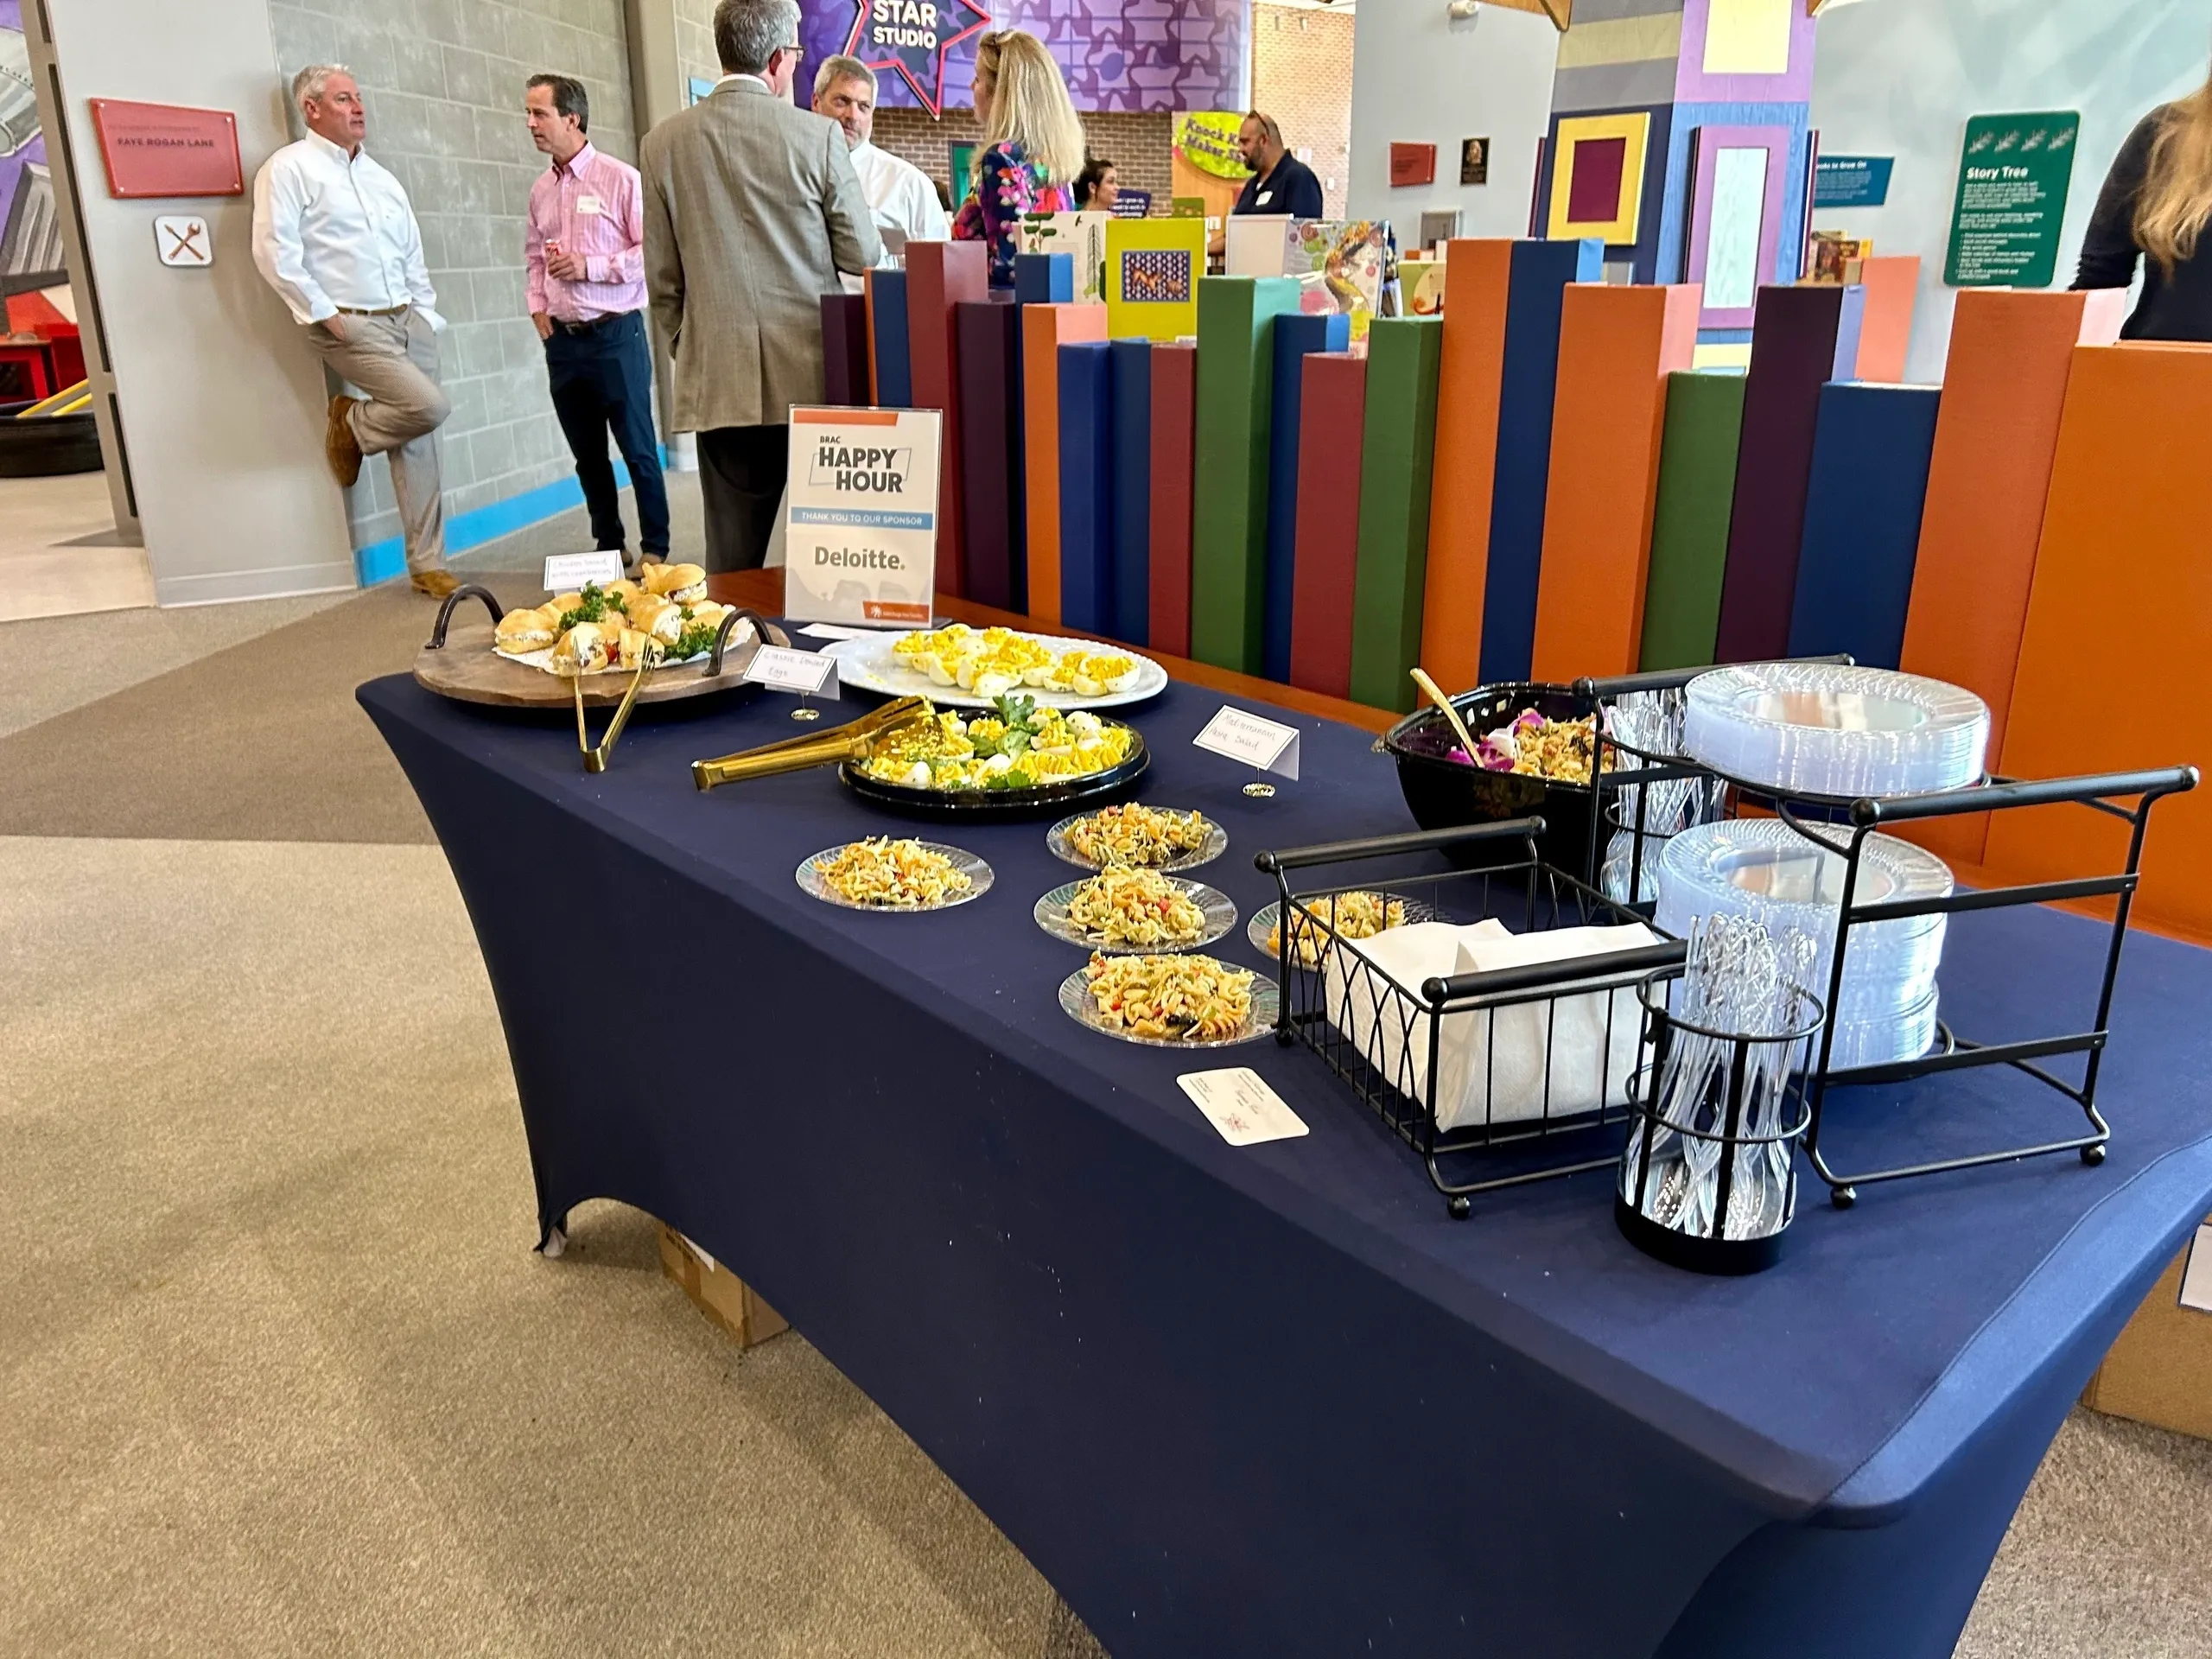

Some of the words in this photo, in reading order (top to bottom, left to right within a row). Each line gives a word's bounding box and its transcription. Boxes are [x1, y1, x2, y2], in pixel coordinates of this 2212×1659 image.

[873, 0, 937, 28] STAR
[873, 26, 937, 49] STUDIO
[1185, 118, 1224, 142] Knock
[118, 137, 143, 147] FAYE
[187, 138, 214, 148] LANE
[1185, 135, 1225, 157] Maker
[1840, 160, 1856, 169] Grow
[1967, 167, 1999, 181] Story
[2001, 165, 2029, 179] Tree
[819, 435, 842, 444] BRAC
[819, 446, 898, 469] HAPPY
[836, 469, 903, 493] HOUR
[801, 511, 829, 522] THANK
[830, 512, 849, 523] YOU
[849, 513, 861, 524] TO
[862, 514, 881, 524] OUR
[882, 516, 923, 526] SPONSOR
[815, 545, 906, 570] Deloitte.
